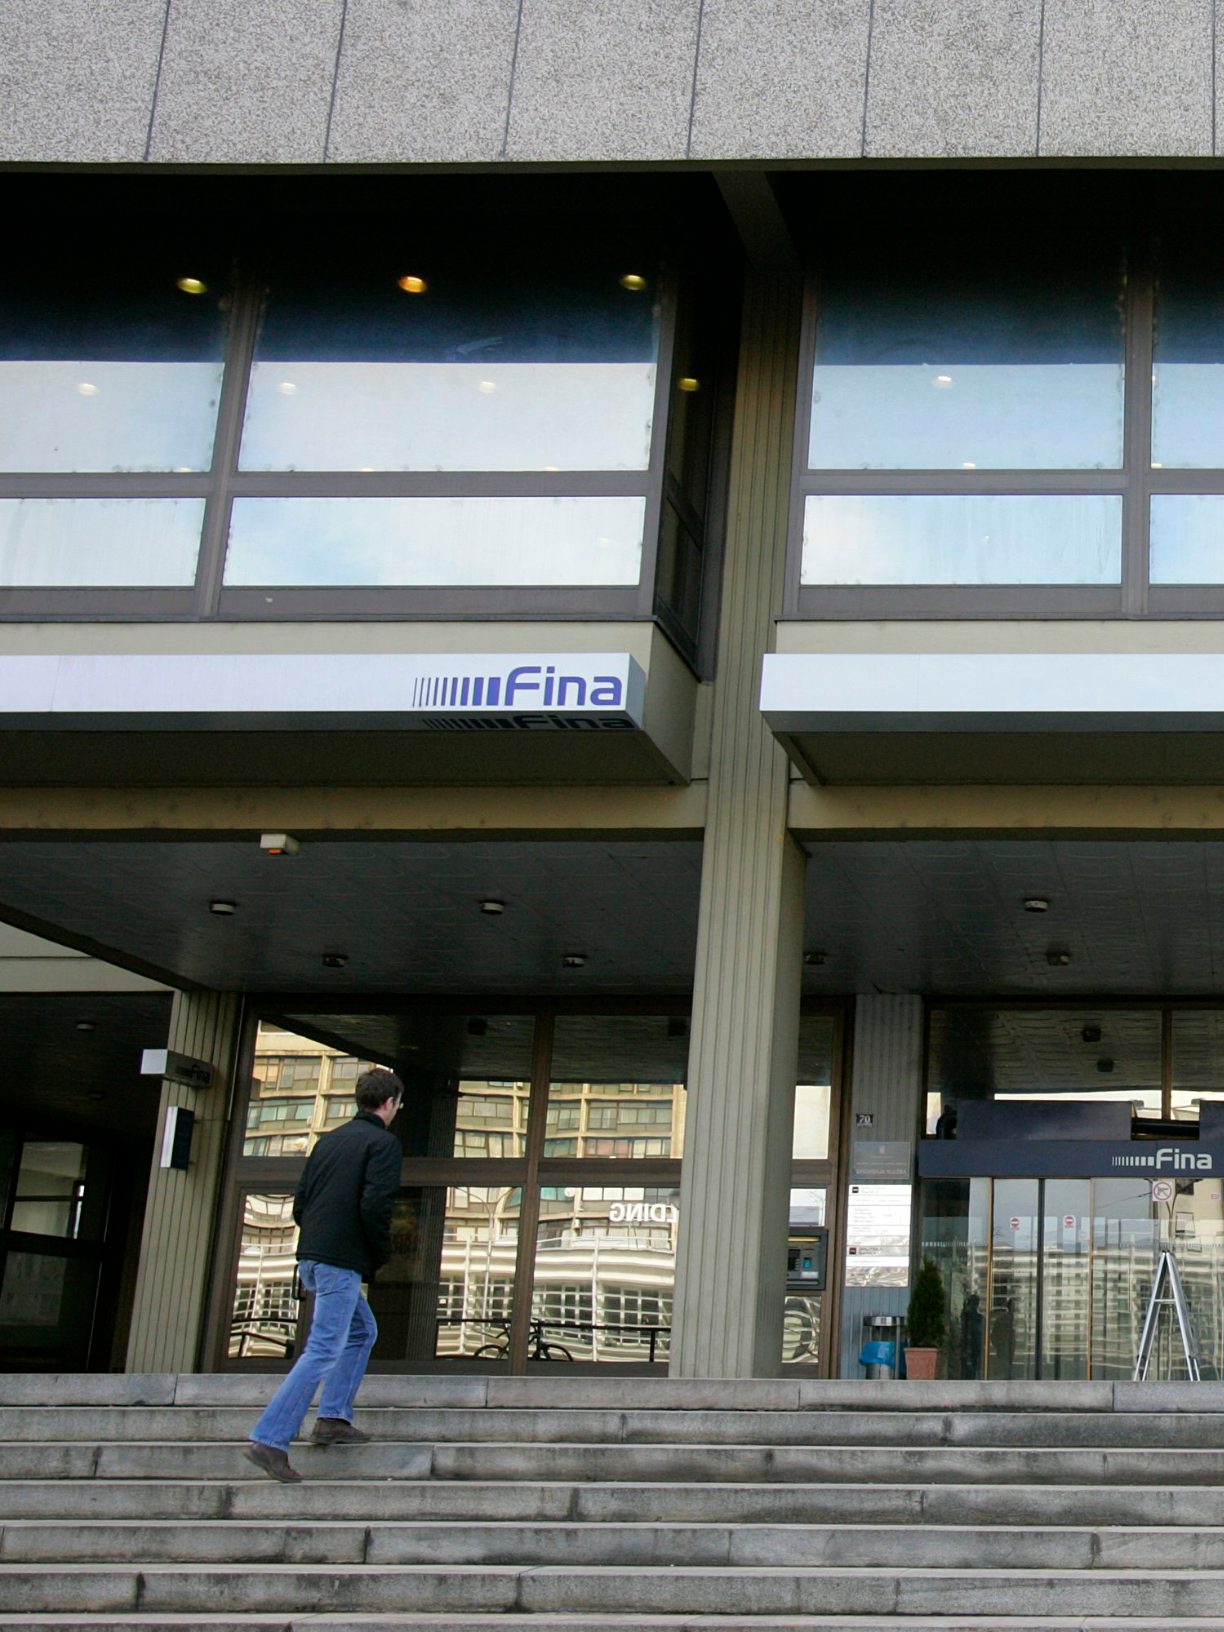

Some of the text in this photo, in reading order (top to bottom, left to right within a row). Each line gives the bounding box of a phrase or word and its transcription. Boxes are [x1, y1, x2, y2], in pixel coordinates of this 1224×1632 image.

[504, 666, 622, 706] Fina
[859, 1114, 871, 1124] 70
[1155, 1148, 1213, 1170] Fina
